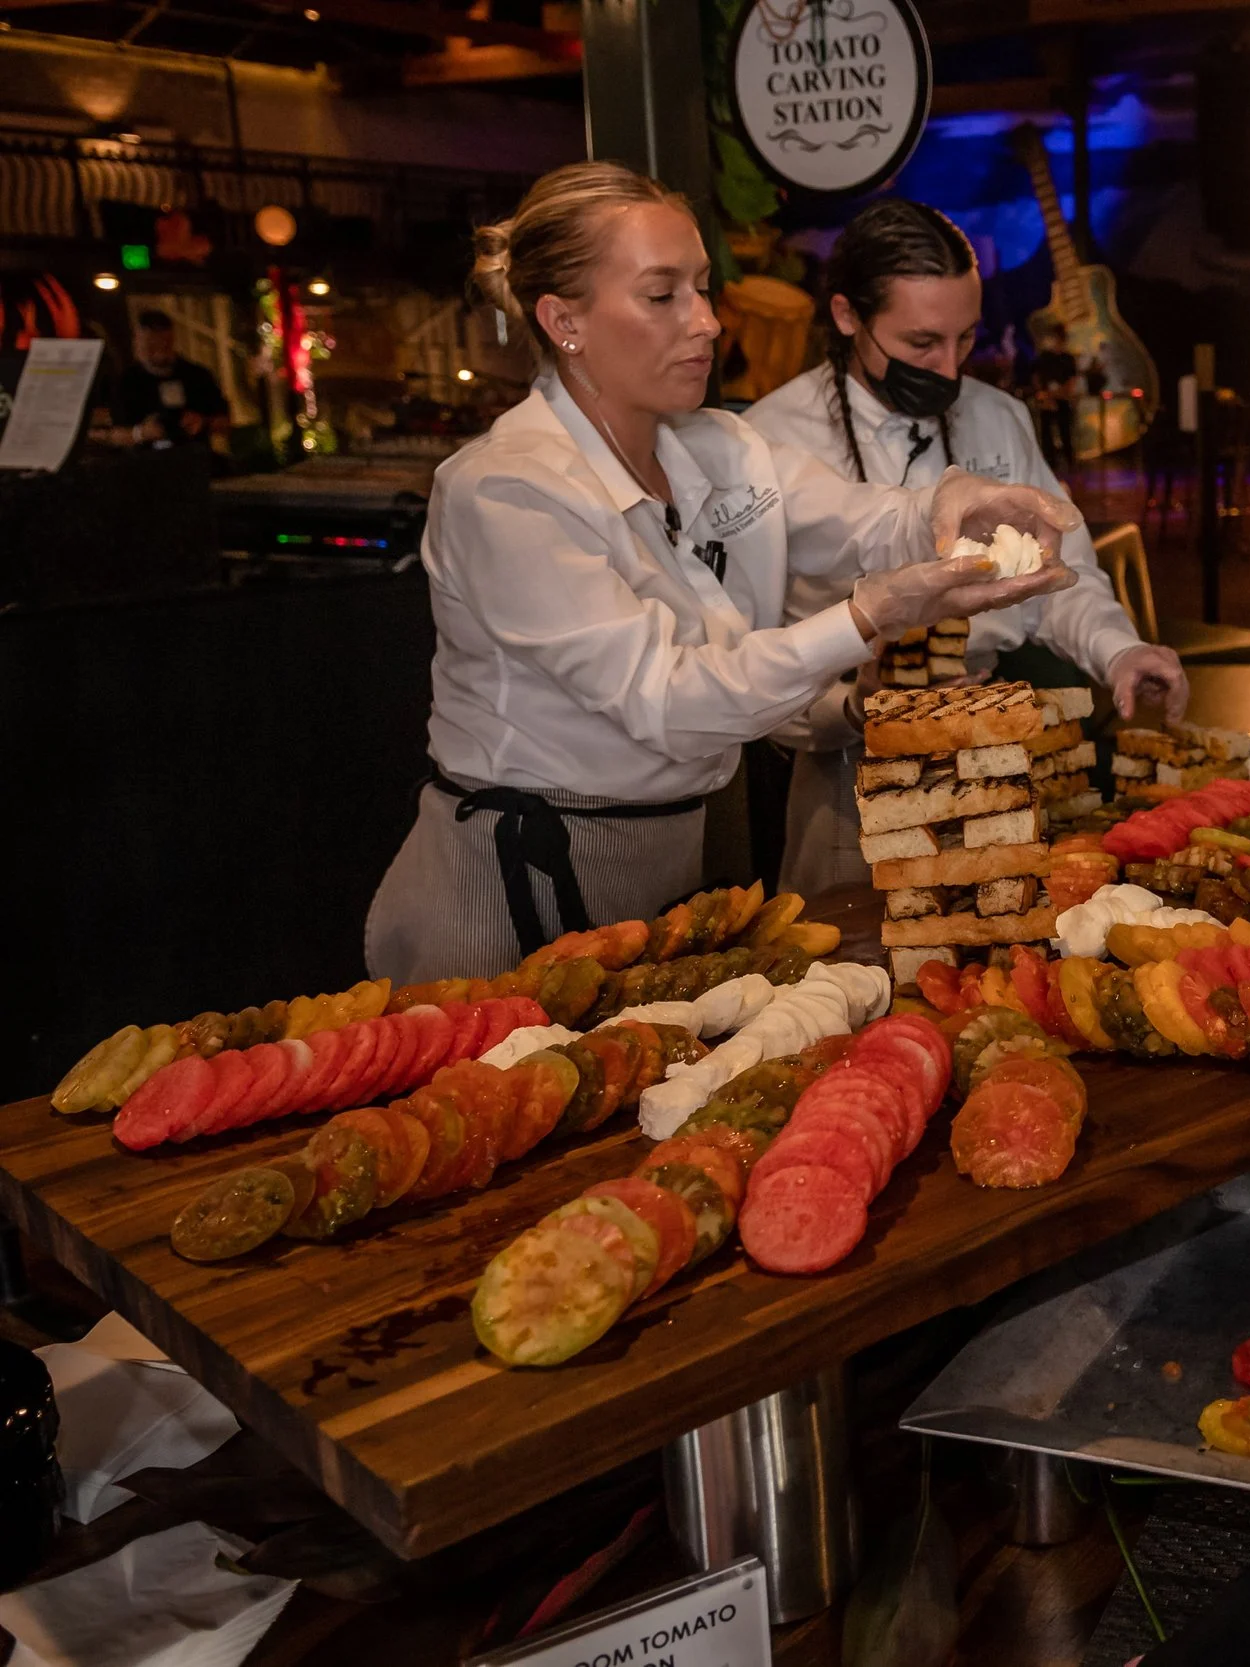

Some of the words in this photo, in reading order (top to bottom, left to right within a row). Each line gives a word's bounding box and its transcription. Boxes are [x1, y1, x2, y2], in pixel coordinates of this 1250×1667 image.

[768, 35, 880, 65] TOMATO
[767, 64, 886, 96] CARVING
[773, 96, 882, 125] STATION
[640, 1604, 736, 1654] TOMATO
